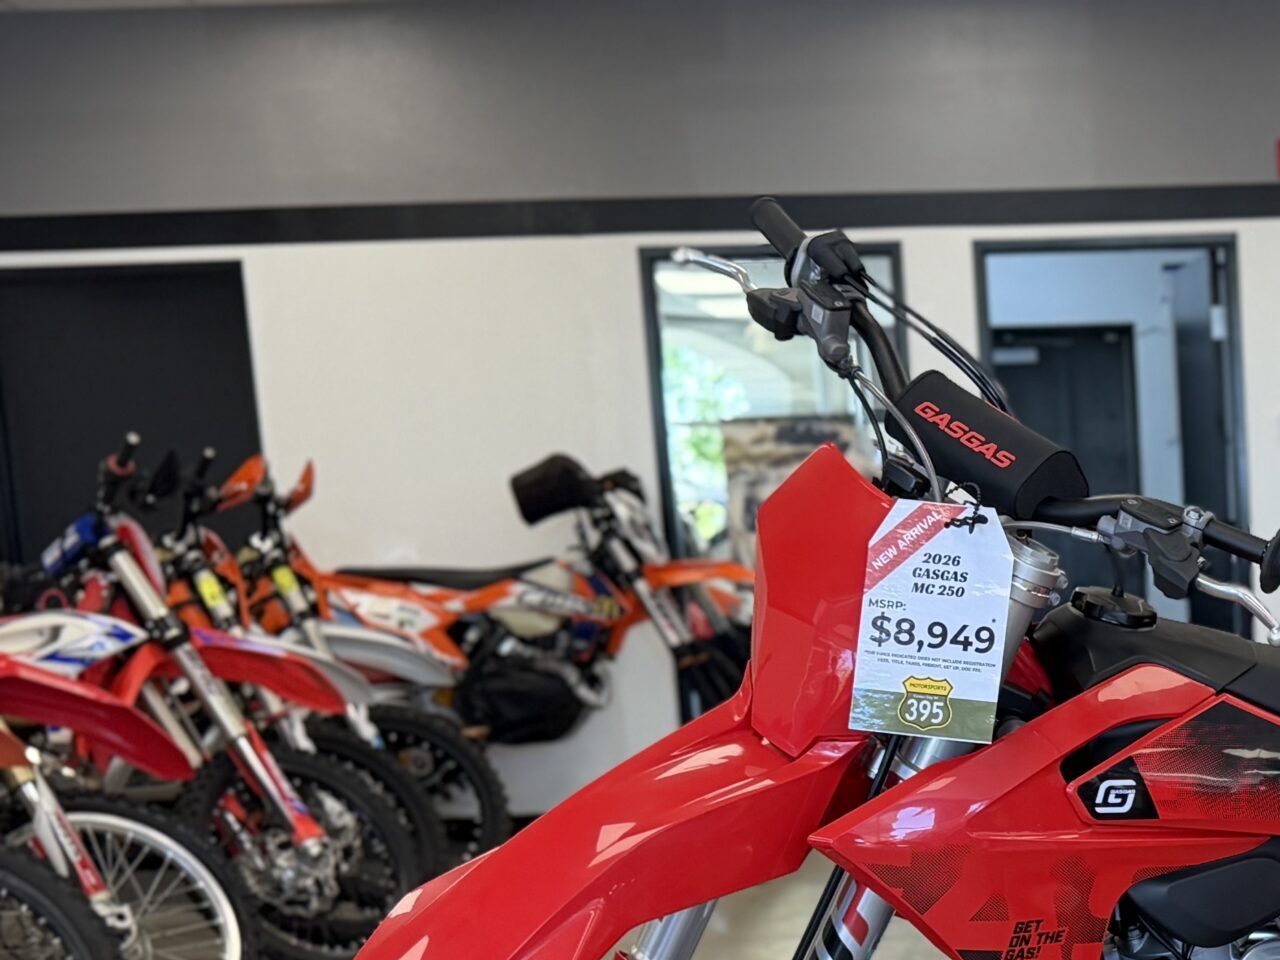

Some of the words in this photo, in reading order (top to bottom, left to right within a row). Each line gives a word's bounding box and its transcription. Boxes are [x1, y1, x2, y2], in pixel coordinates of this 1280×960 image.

[914, 401, 1016, 468] GASGAS
[871, 546, 898, 570] NEW
[922, 553, 961, 567] 2026
[912, 567, 969, 583] GASGAS
[911, 582, 935, 595] MC
[937, 585, 965, 598] 250
[868, 598, 907, 611] MSRP:
[870, 611, 996, 655] $8,949
[909, 682, 947, 692] MOTORSPORTS
[904, 698, 944, 724] 395
[1013, 919, 1044, 935] GET
[1008, 934, 1032, 948] ON
[1037, 929, 1066, 946] THE
